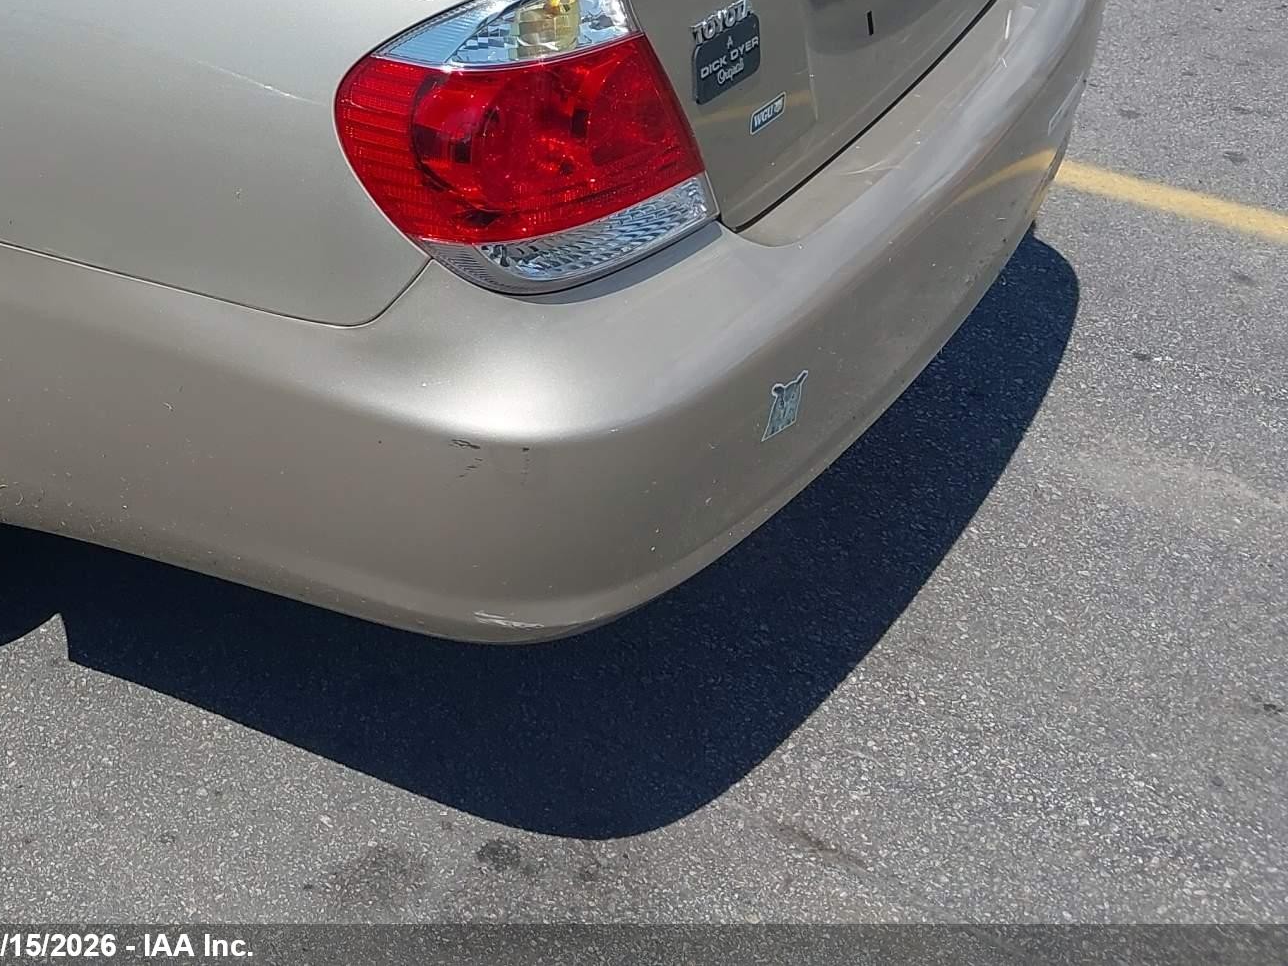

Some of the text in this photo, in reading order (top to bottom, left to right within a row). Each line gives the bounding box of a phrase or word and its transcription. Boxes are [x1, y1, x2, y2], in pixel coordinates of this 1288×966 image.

[727, 35, 733, 49] A
[701, 36, 759, 78] DICK DYER
